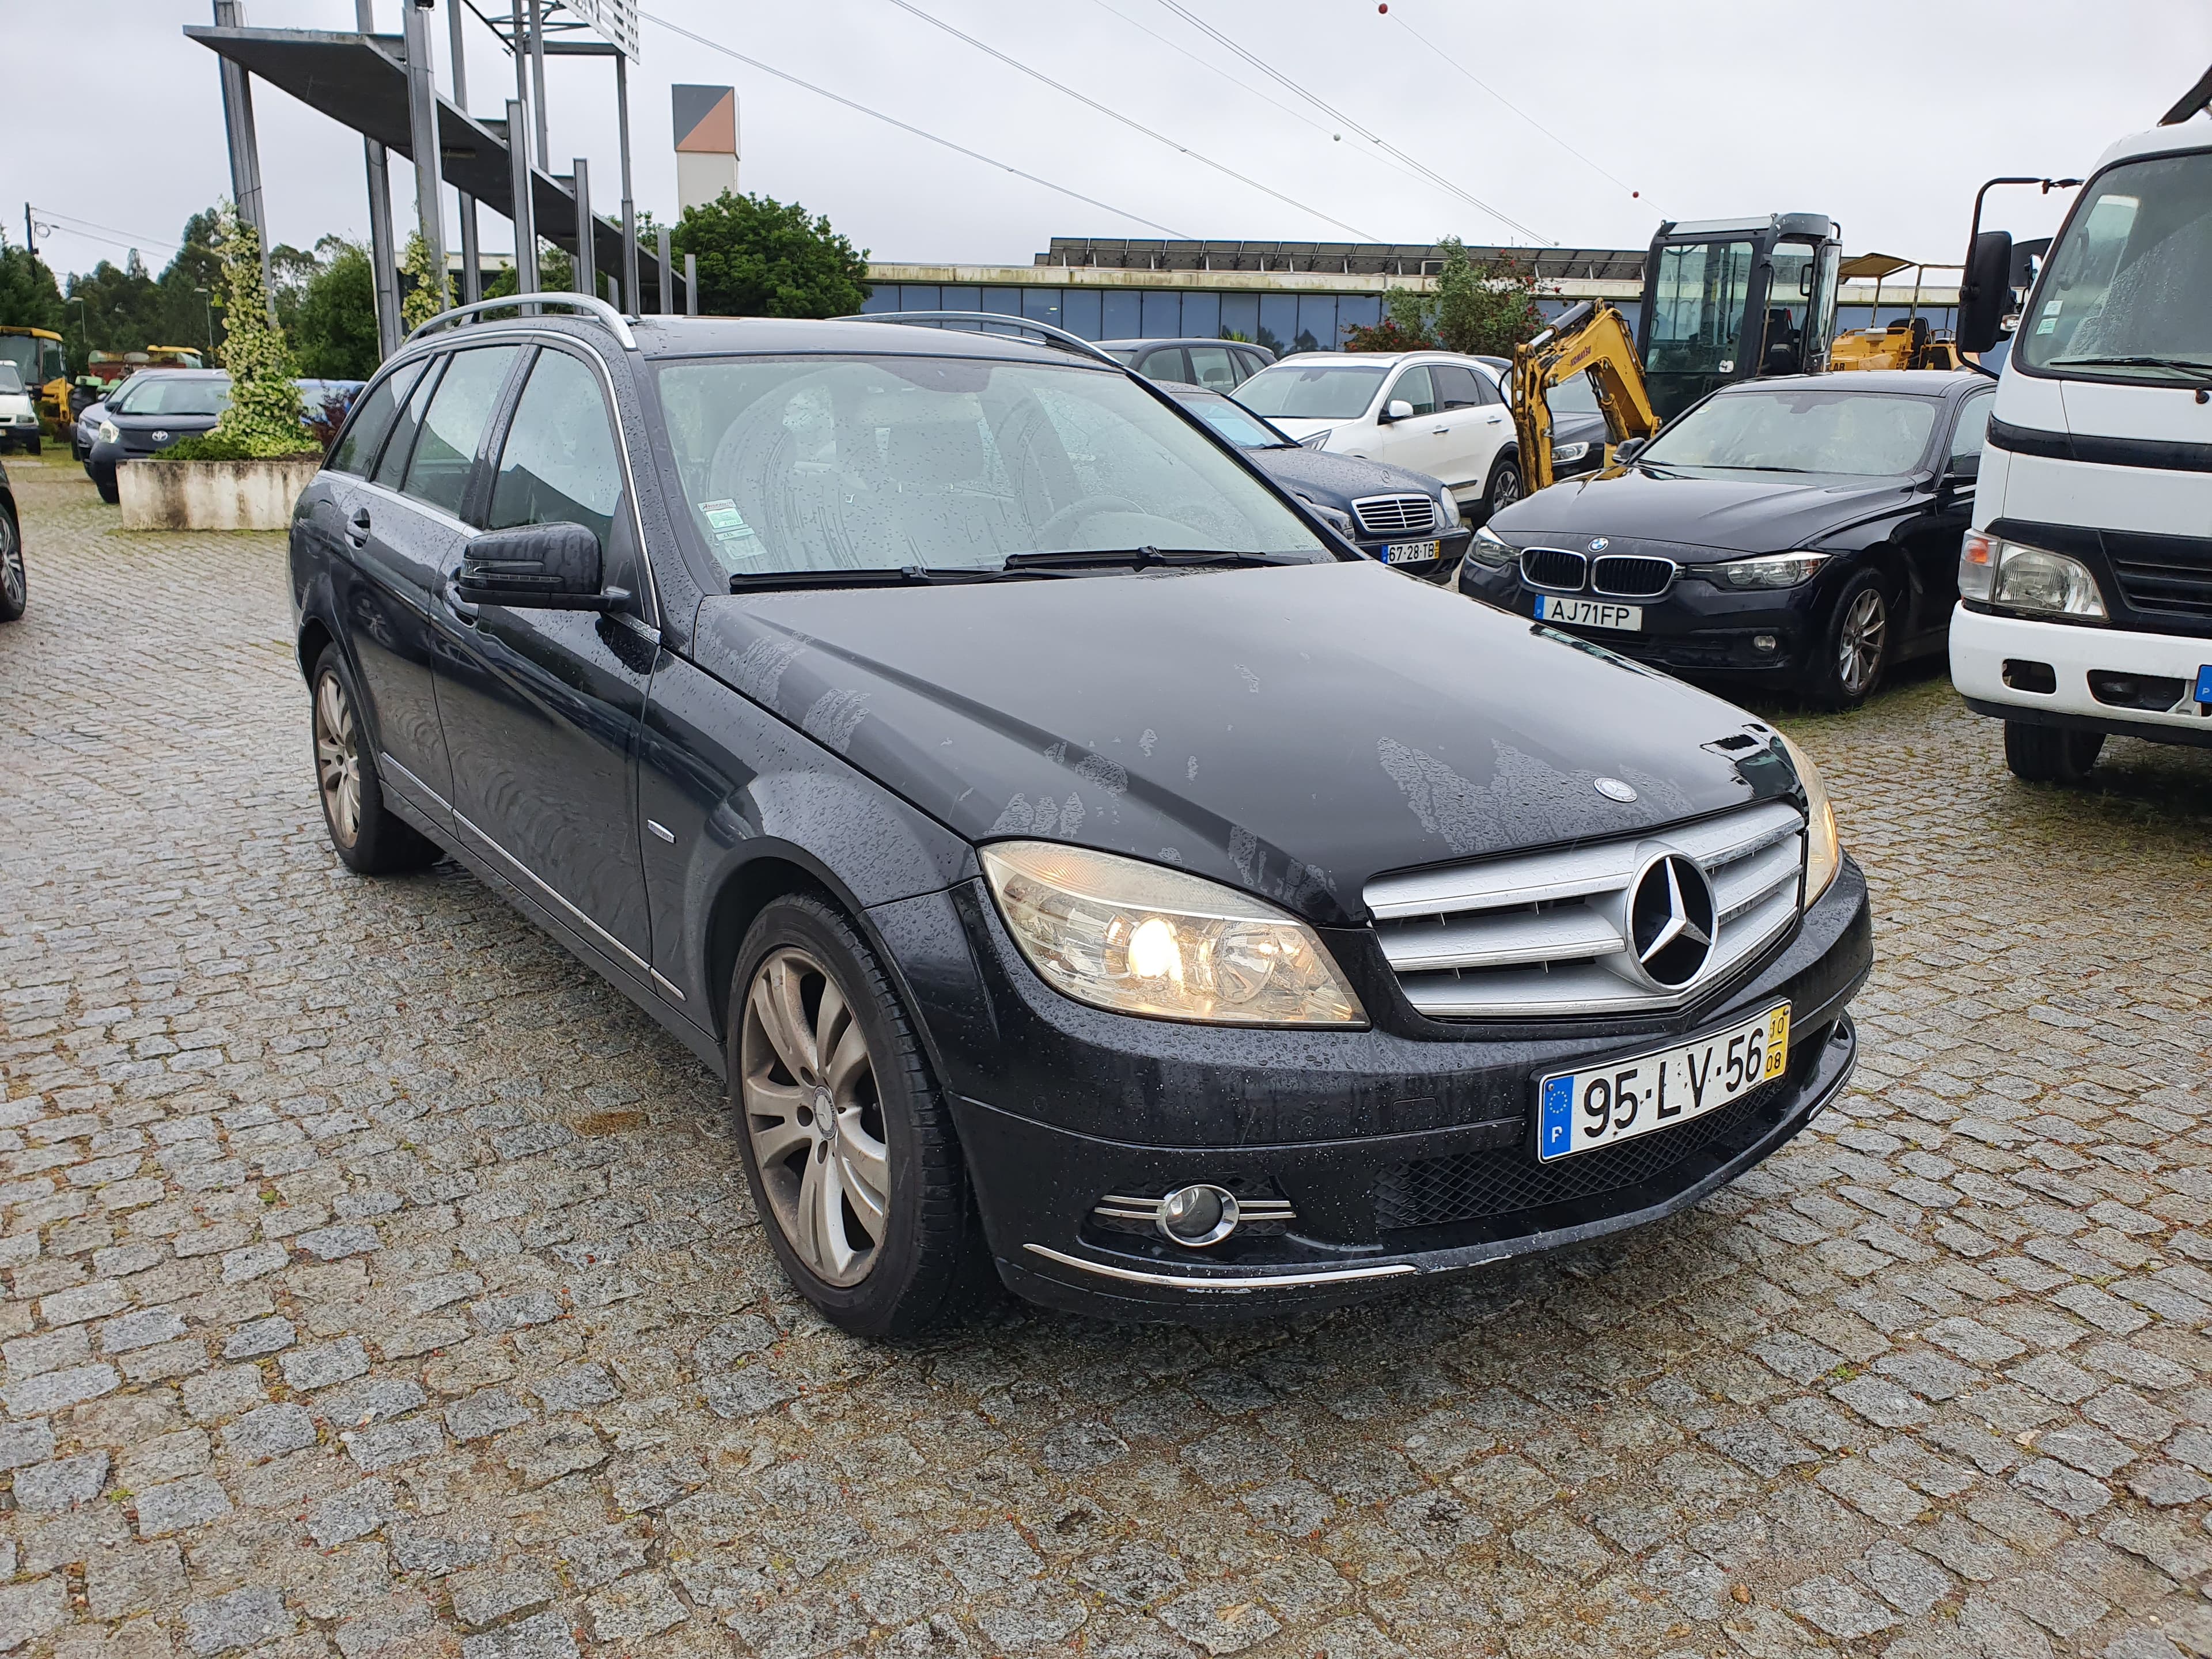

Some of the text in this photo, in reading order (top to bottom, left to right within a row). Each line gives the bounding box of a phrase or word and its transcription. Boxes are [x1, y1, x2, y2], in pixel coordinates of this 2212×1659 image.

[1551, 600, 1630, 626] AJ71FP
[1770, 1017, 1785, 1038] 10
[1766, 1051, 1781, 1072] 08
[1551, 1126, 1563, 1143] P
